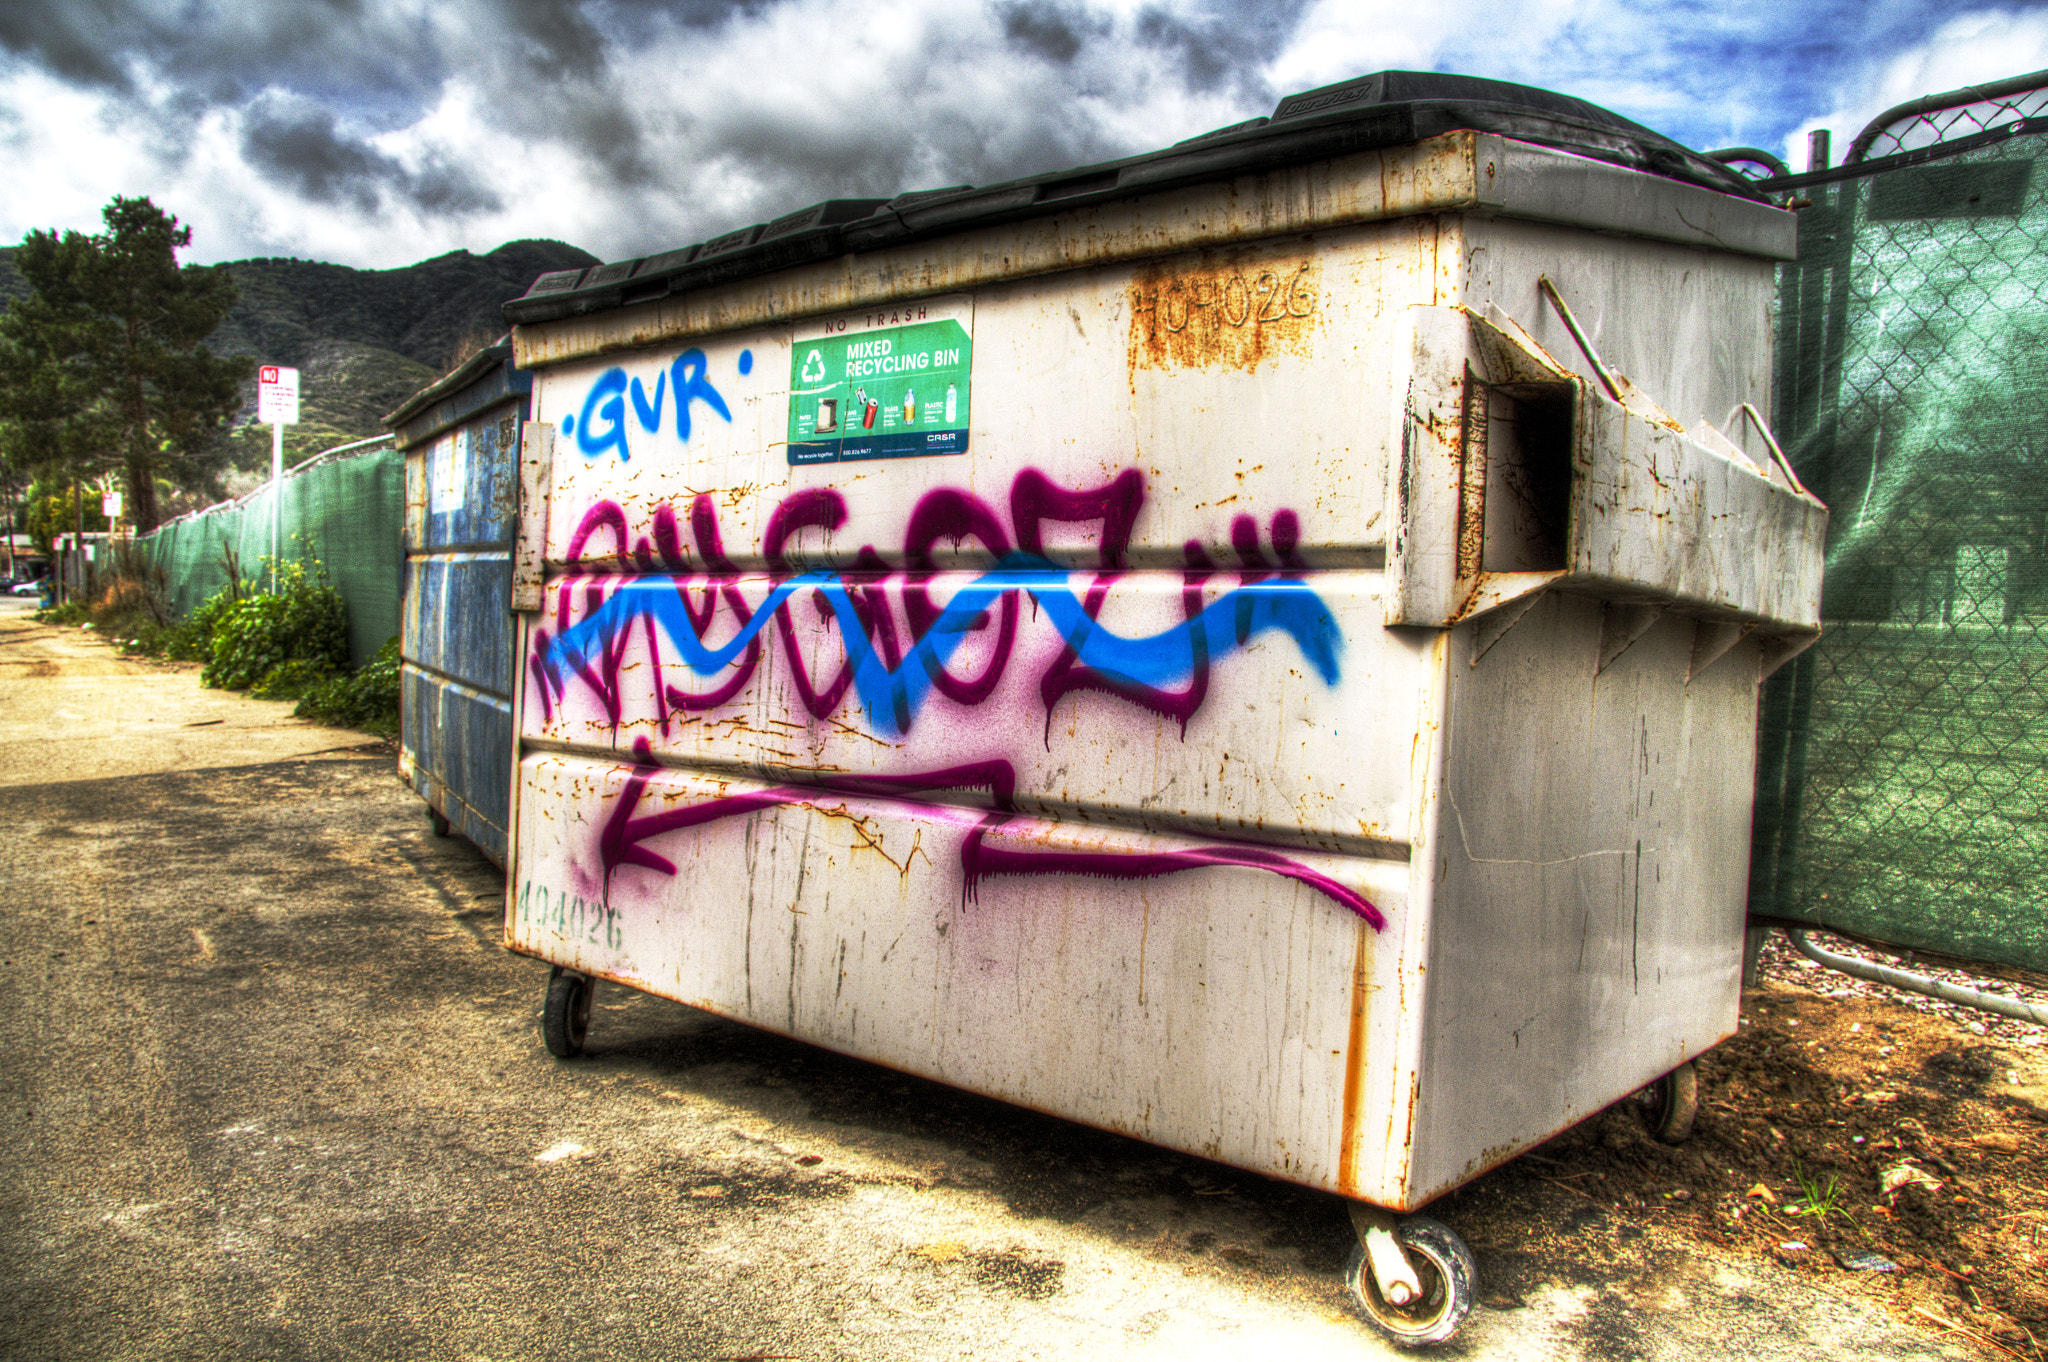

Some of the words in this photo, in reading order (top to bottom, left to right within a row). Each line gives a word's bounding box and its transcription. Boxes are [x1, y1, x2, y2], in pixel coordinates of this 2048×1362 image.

[825, 319, 847, 334] NO
[866, 306, 928, 328] TRASH
[846, 339, 892, 360] MIXED
[845, 351, 930, 378] RECYCLING
[934, 347, 960, 368] BIN
[262, 369, 277, 383] NO
[883, 405, 899, 413] GLASS
[924, 401, 944, 409] PLASTIC
[926, 433, 956, 442] CR&R
